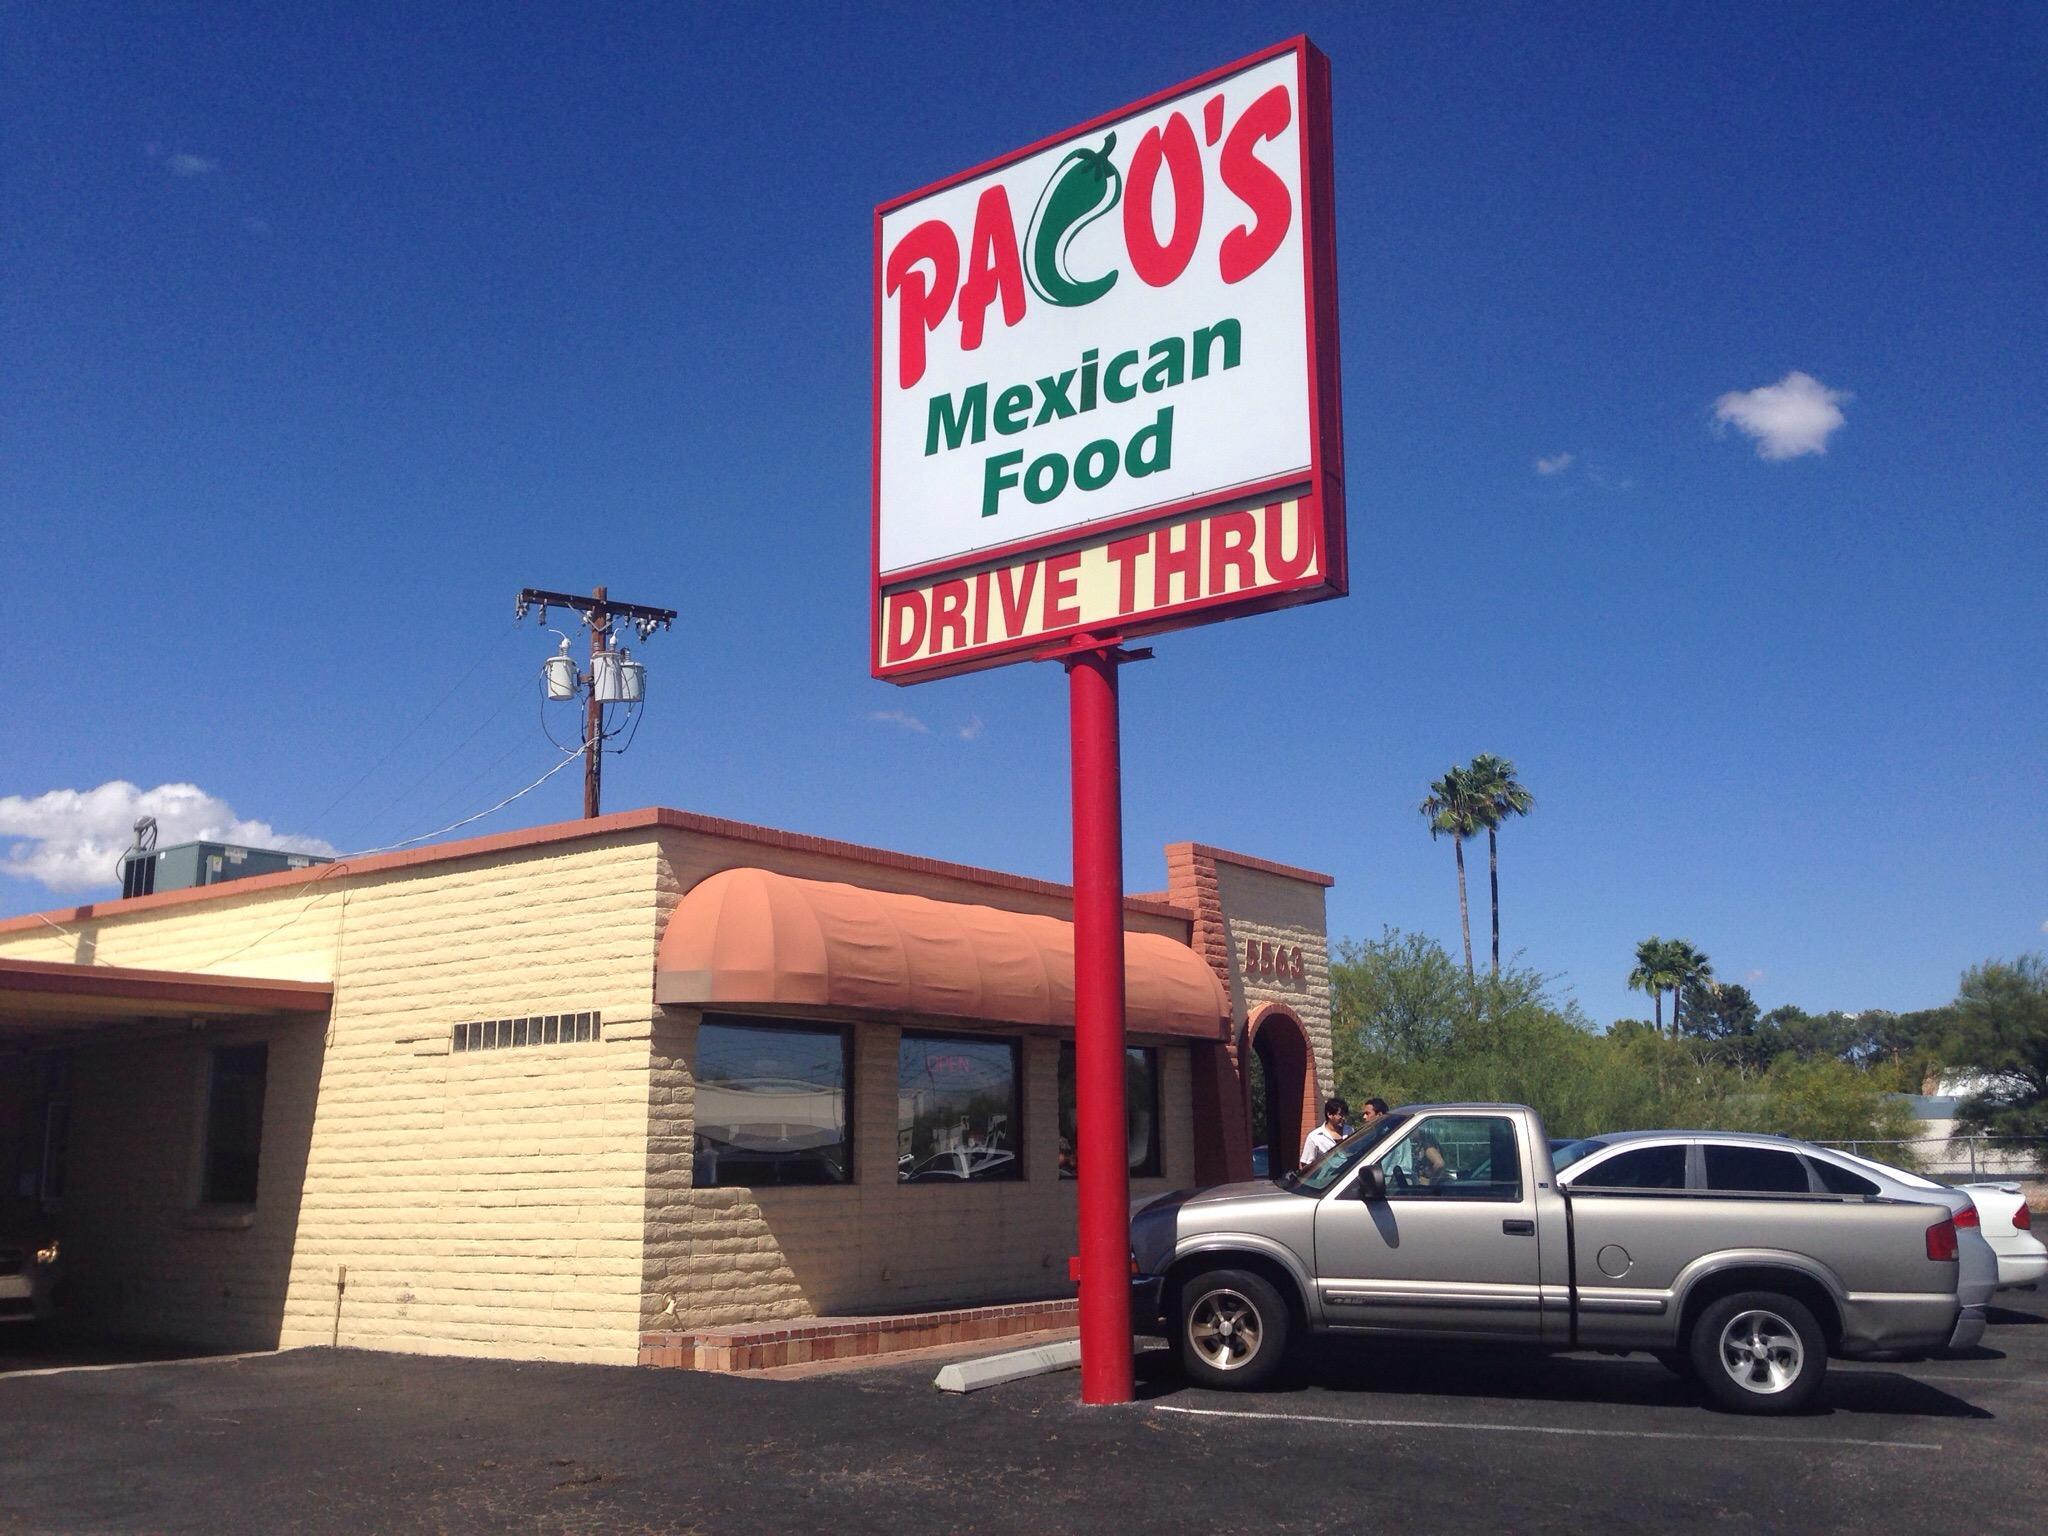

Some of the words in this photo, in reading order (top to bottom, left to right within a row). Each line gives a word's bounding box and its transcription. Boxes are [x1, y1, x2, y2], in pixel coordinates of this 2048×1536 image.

[886, 85, 1292, 389] PACO'S
[925, 317, 1242, 457] Mexican
[981, 407, 1174, 519] Food
[885, 550, 1081, 665] DRIVE
[1107, 500, 1317, 614] THRU
[926, 1055, 971, 1072] OPEN
